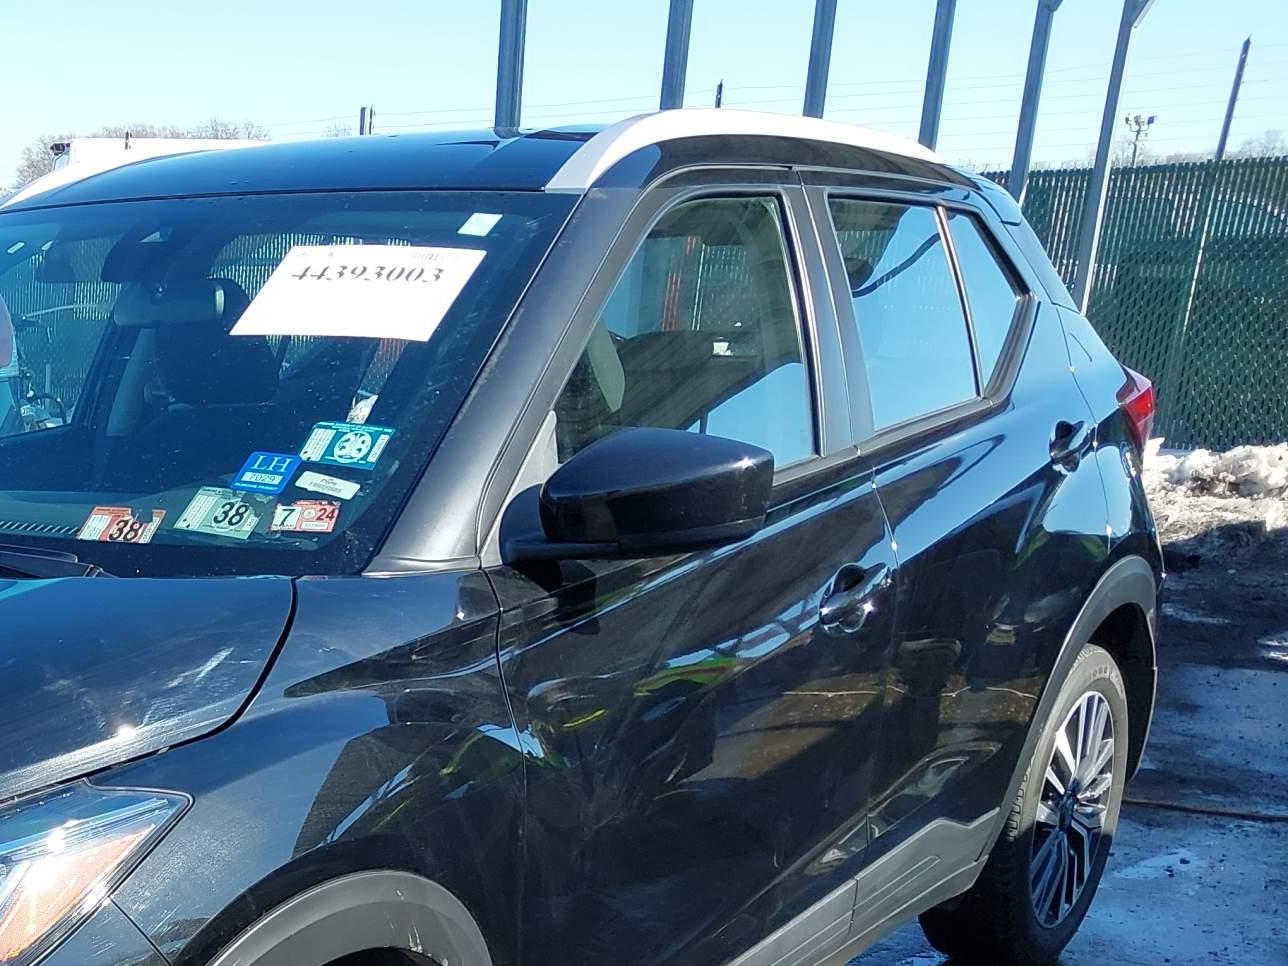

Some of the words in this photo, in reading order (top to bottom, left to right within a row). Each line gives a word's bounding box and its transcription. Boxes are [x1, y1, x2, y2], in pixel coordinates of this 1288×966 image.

[291, 264, 444, 283] 44393003
[250, 454, 293, 473] LH
[213, 502, 249, 526] 38
[280, 508, 297, 526] 7
[318, 508, 336, 522] 24
[109, 519, 141, 541] 38
